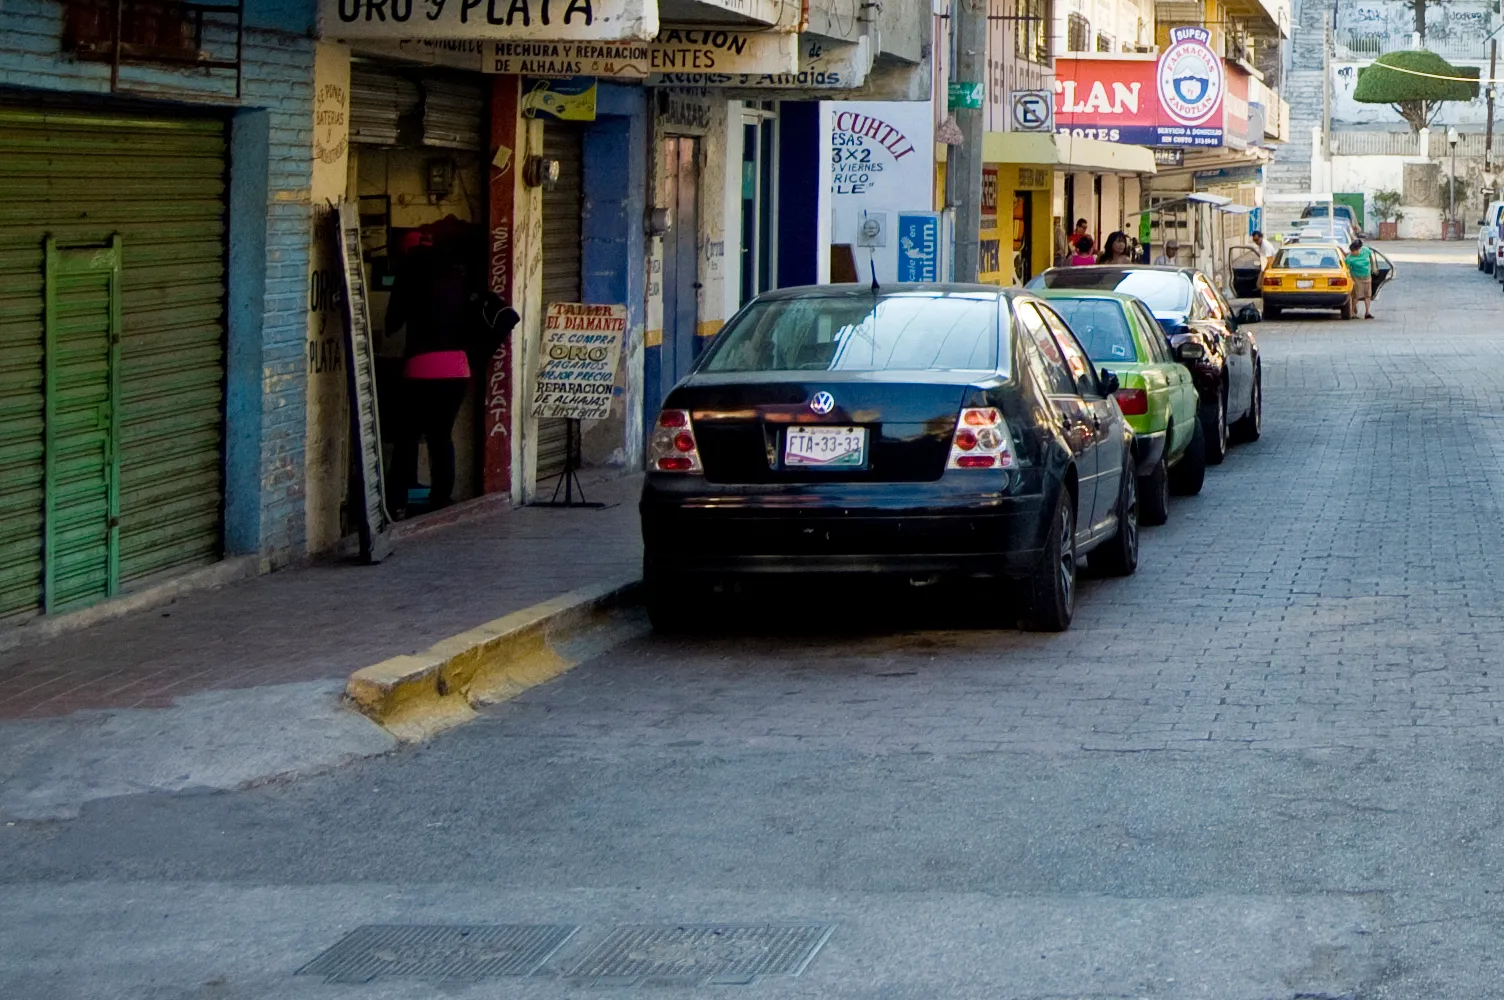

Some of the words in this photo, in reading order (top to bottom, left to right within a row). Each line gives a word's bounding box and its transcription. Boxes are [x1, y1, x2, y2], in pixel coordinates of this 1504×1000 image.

[1176, 28, 1207, 43] SUPER
[495, 43, 560, 57] HECHURA
[576, 45, 649, 60] REPARACION
[651, 50, 715, 68] ENTES
[1167, 46, 1214, 72] FARMACIAS
[495, 61, 511, 73] DE
[520, 61, 582, 74] ALHAJAS
[1169, 95, 1213, 115] ZAPOTLAN
[840, 163, 883, 172] VIERNES
[554, 304, 613, 317] TALLER
[546, 316, 560, 329] EL
[565, 316, 626, 331] DIAMANTE
[548, 333, 565, 342] SE
[568, 333, 616, 344] COMPRA
[550, 344, 608, 361] ORO
[544, 360, 608, 370] PAGAMOS
[536, 382, 613, 395] REPARACION
[535, 394, 551, 403] DE
[554, 395, 609, 406] ALHAJAS
[790, 436, 860, 452] FTA-33-33
